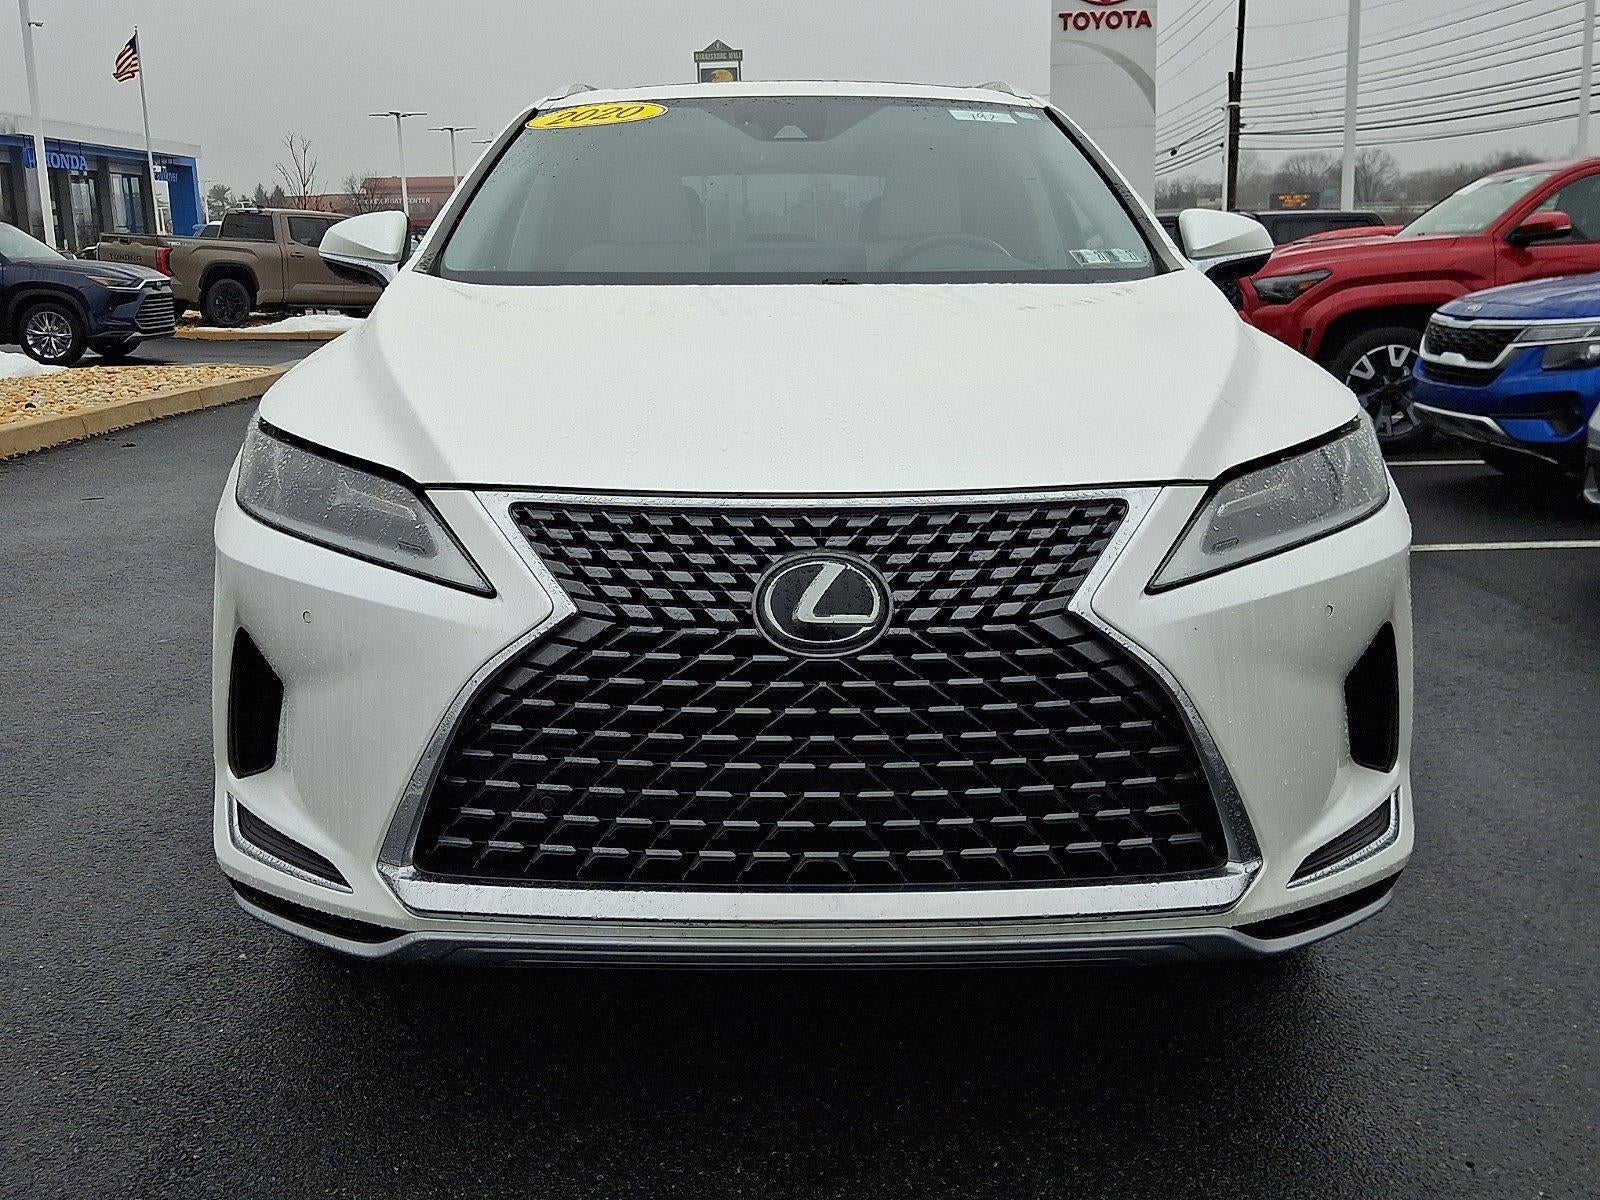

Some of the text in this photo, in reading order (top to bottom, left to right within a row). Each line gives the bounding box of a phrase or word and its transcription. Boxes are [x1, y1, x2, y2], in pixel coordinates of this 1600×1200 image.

[1058, 10, 1152, 31] TOYOTA
[545, 106, 645, 127] 2020
[109, 252, 142, 261] TUNDRA
